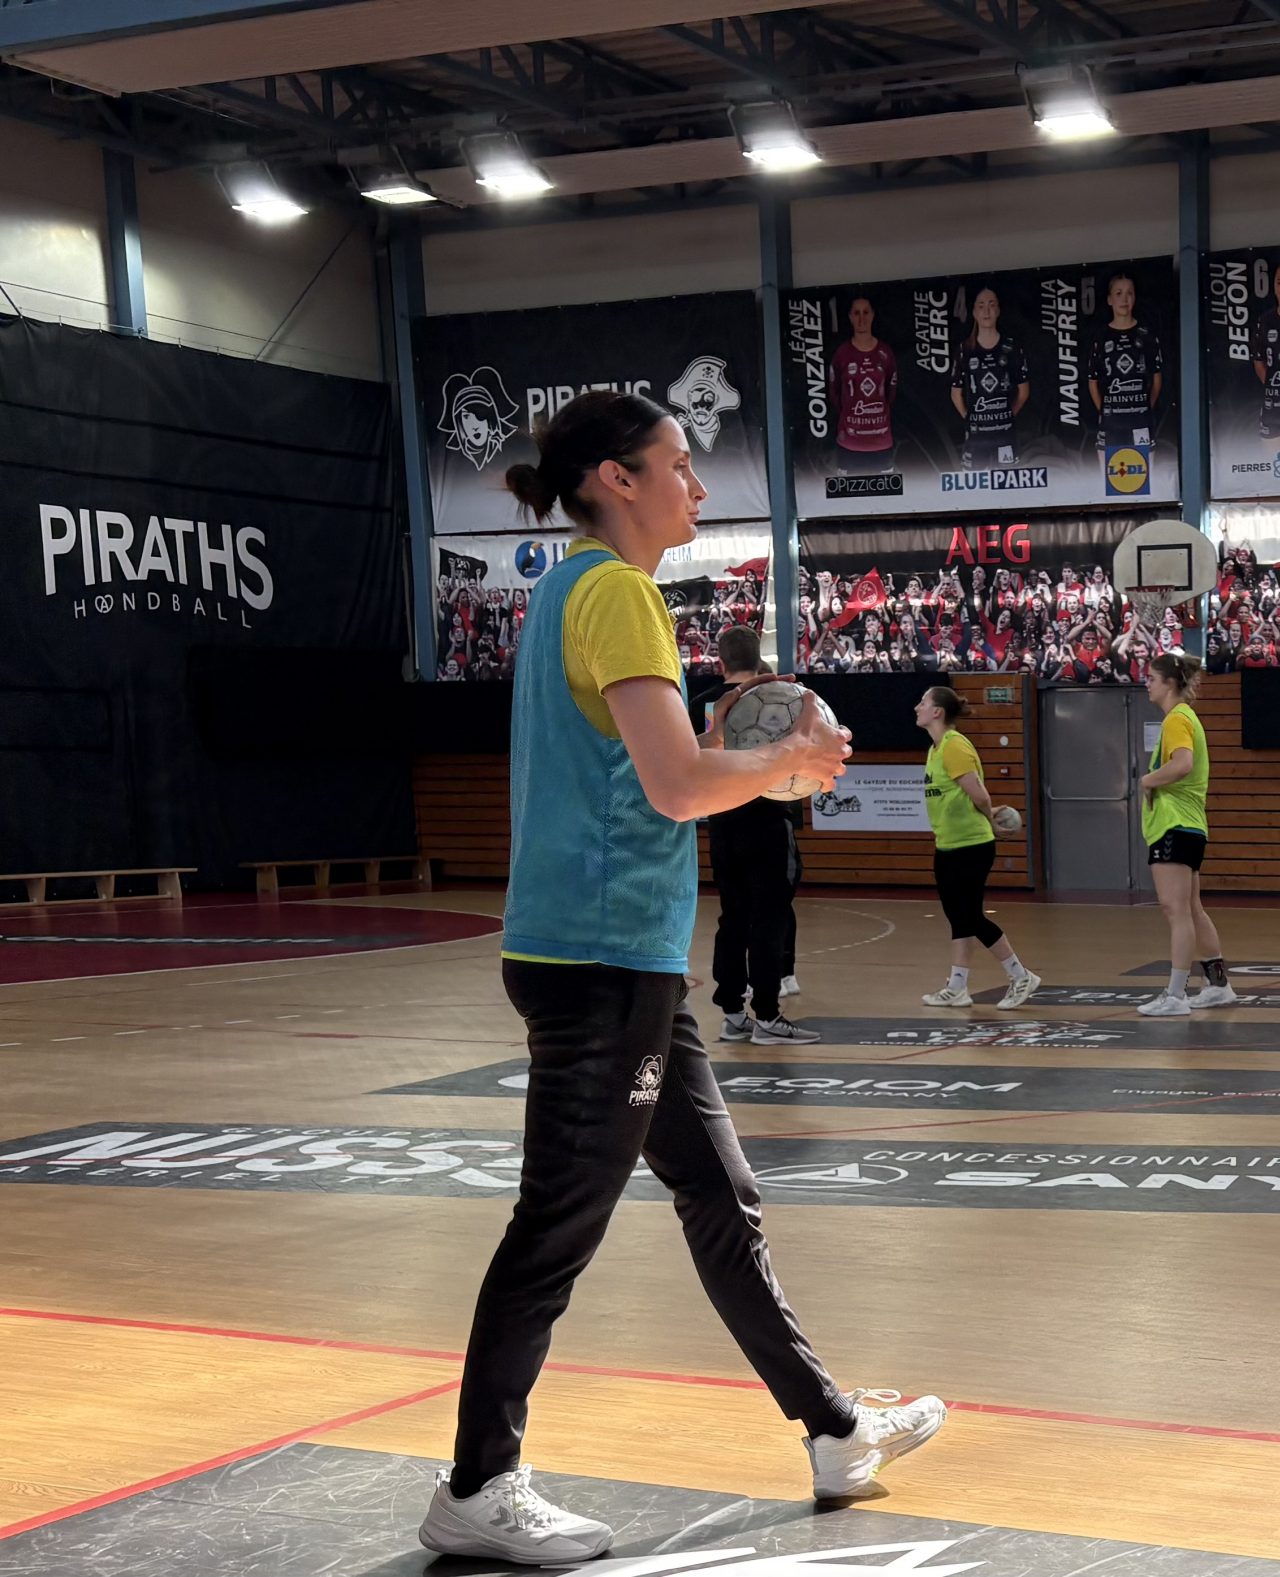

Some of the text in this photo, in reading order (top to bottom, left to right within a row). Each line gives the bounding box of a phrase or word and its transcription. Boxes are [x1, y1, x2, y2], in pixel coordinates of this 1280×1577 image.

[1081, 276, 1096, 316] 5
[1209, 263, 1228, 325] LILOU
[1253, 258, 1270, 299] 6
[788, 299, 806, 363] LÉANE
[914, 291, 931, 371] AGATHE
[929, 291, 950, 374] CLERC
[1041, 279, 1057, 335] JULIA
[1226, 262, 1250, 361] BEGON
[802, 299, 828, 438] GONZALEZ
[1057, 279, 1080, 426] MAUFFREY
[1232, 463, 1271, 474] PIERRES
[39, 503, 274, 611] PIRATHS
[945, 523, 1031, 565] AEG
[718, 1076, 1023, 1093] EQIOM
[802, 1088, 959, 1098] COMPANY
[220, 1126, 451, 1139] GROUPE
[340, 1175, 412, 1184] TP
